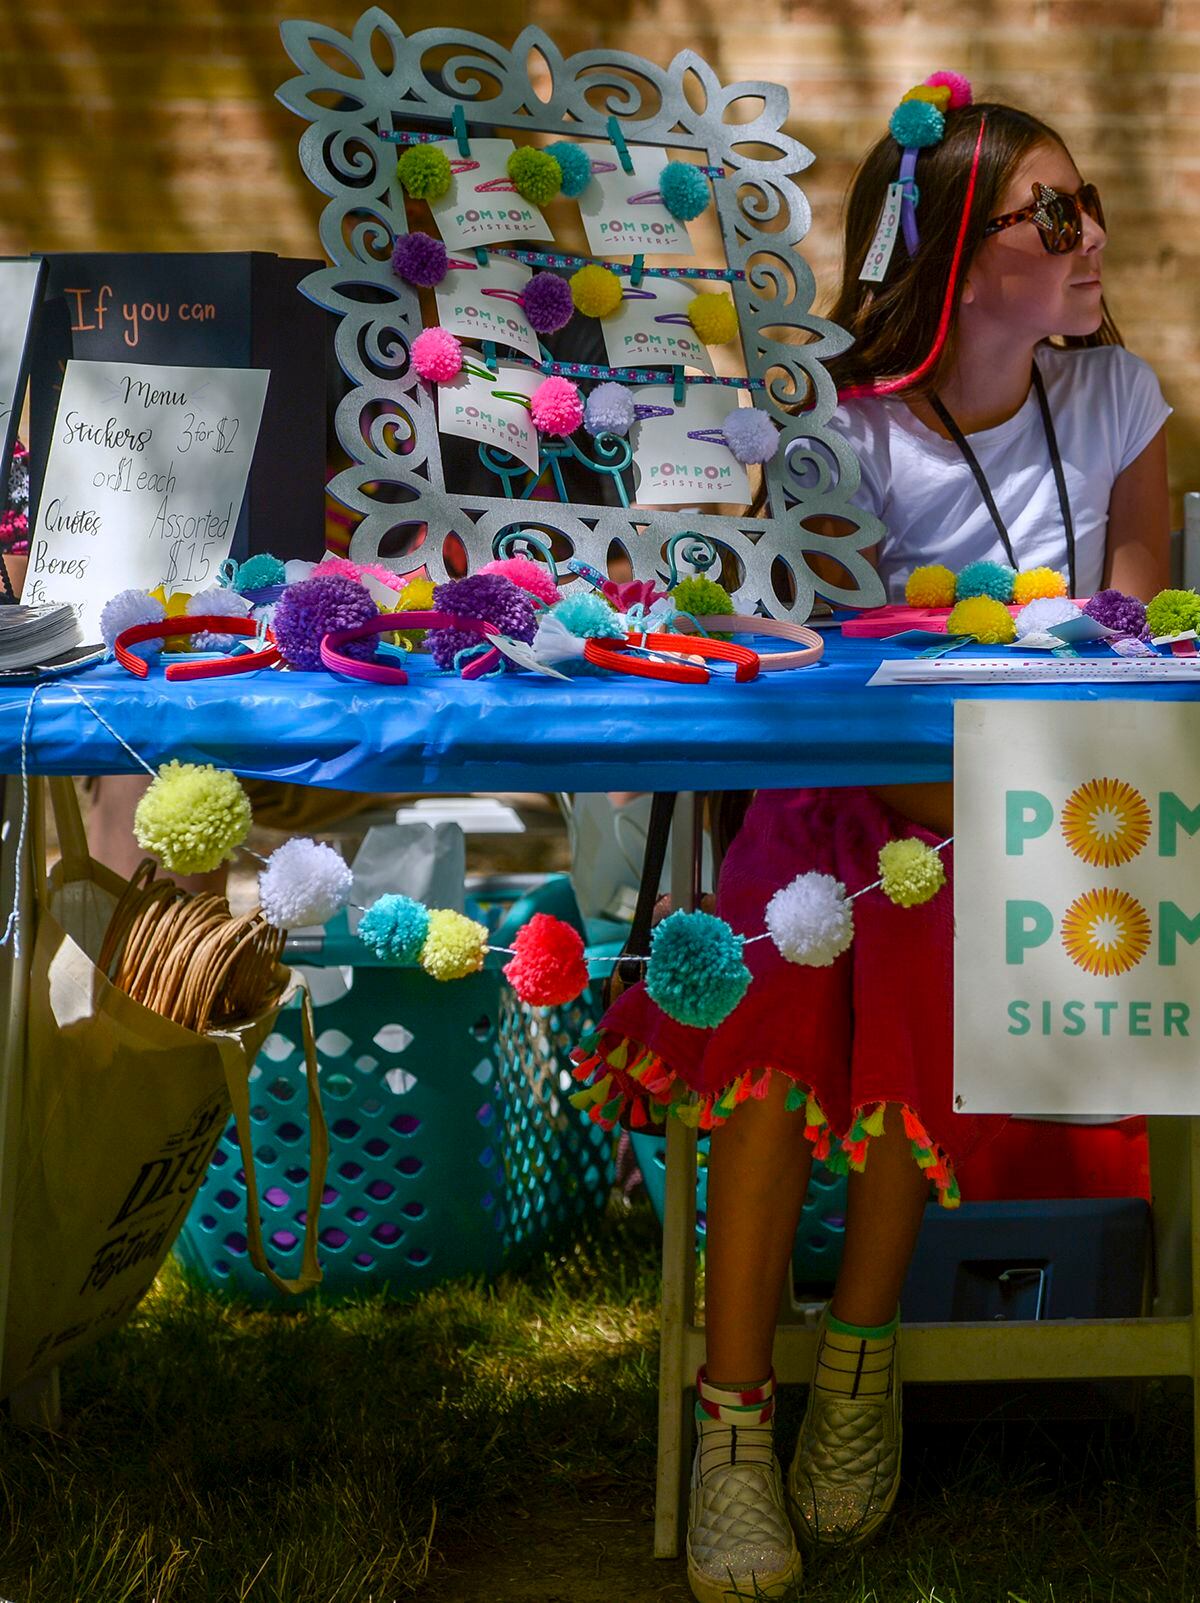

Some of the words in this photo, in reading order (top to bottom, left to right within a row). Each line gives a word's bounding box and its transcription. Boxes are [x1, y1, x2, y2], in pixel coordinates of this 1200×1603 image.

[456, 209, 493, 226] POM
[499, 208, 533, 222] POM
[471, 223, 530, 233] SISTERS
[600, 220, 636, 234] POM
[642, 222, 677, 236] POM
[613, 235, 671, 245] SISTERS
[64, 285, 113, 331] If
[123, 303, 170, 347] you
[178, 303, 216, 322] can
[455, 306, 492, 321] POM
[497, 315, 529, 337] POM
[624, 332, 662, 346] POM
[667, 337, 701, 353] POM
[120, 376, 187, 408] Menu
[63, 411, 153, 452] Stickers
[456, 406, 492, 423] POM
[498, 415, 528, 442] POM
[136, 461, 176, 493] each
[651, 462, 688, 477] POM
[695, 465, 731, 480] POM
[663, 480, 723, 490] SISTERS
[44, 498, 103, 537] Quotes
[149, 495, 232, 541] Assorted
[34, 540, 88, 579] Boxes
[160, 539, 215, 583] $15
